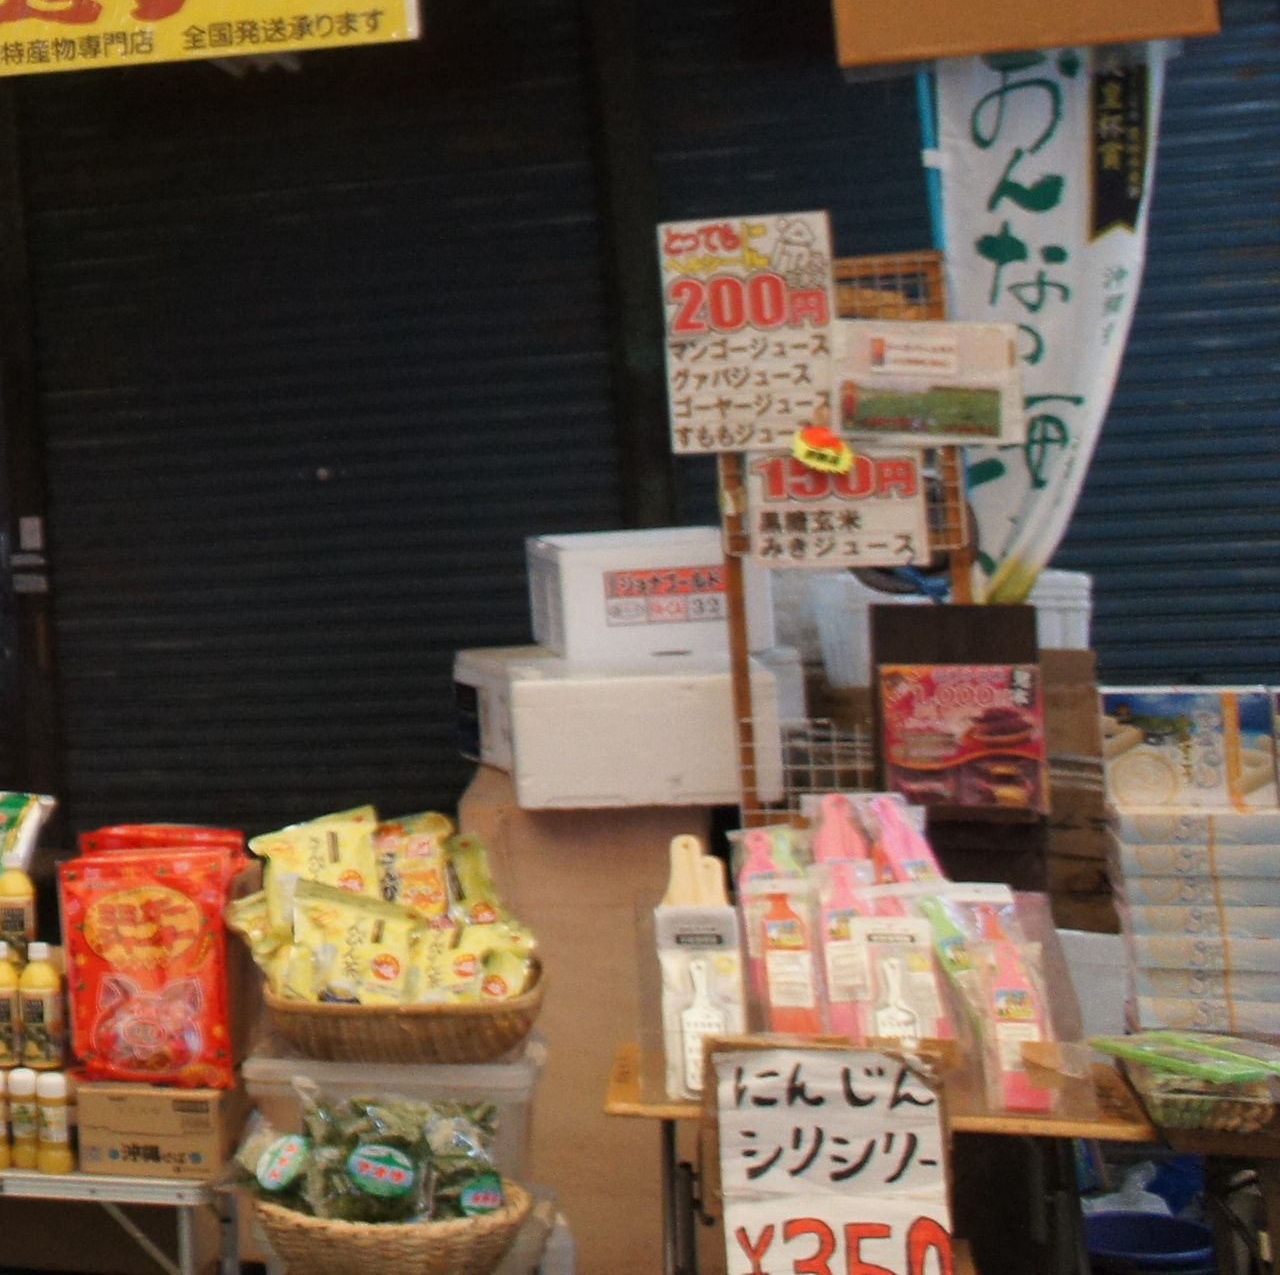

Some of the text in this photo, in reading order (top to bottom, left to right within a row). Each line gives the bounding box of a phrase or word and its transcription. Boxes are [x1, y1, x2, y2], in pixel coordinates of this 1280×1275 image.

[181, 8, 385, 51] 全国発送承ります
[667, 272, 831, 336] 200円
[669, 333, 830, 364] マンゴージュース
[673, 390, 833, 419] ゴーヤージュース
[674, 422, 794, 447] すももジュー
[734, 1063, 938, 1110] にんじん
[739, 1125, 938, 1183] シリシリー
